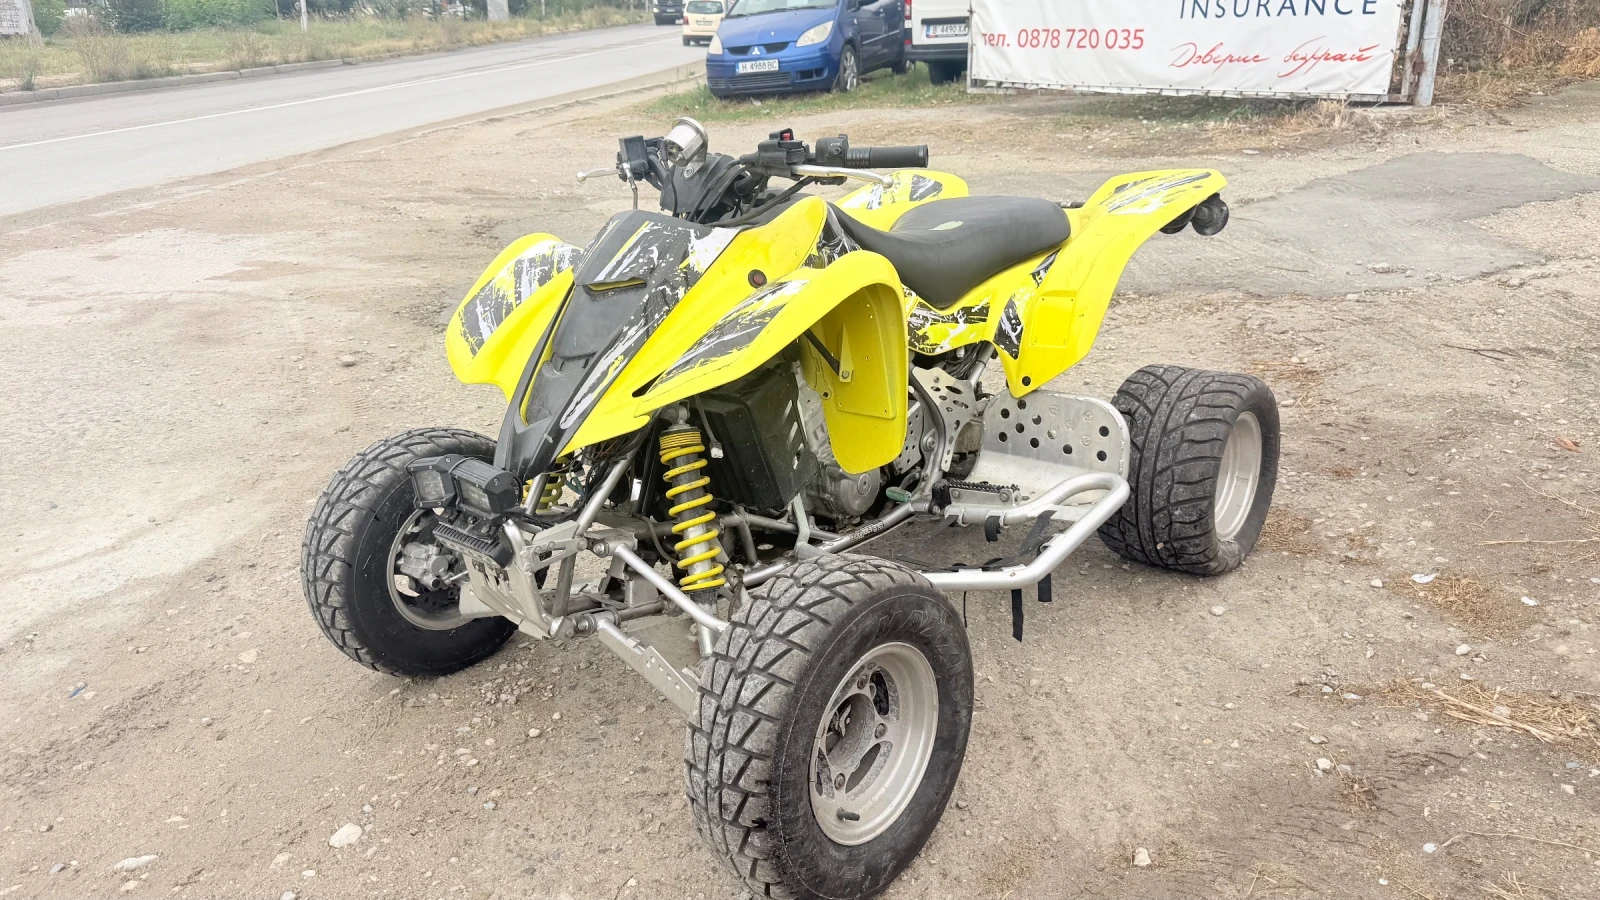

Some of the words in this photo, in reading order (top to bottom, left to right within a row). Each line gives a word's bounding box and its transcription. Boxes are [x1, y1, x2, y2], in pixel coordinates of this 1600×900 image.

[1180, 0, 1376, 19] INSURANCE
[941, 25, 956, 33] 4490
[981, 33, 1011, 48] тел.
[1017, 28, 1061, 48] 0878
[1066, 28, 1100, 49] 720
[1105, 28, 1145, 50] 035
[750, 62, 766, 70] 4988
[768, 61, 776, 69] BC
[1168, 42, 1270, 75] Доверие
